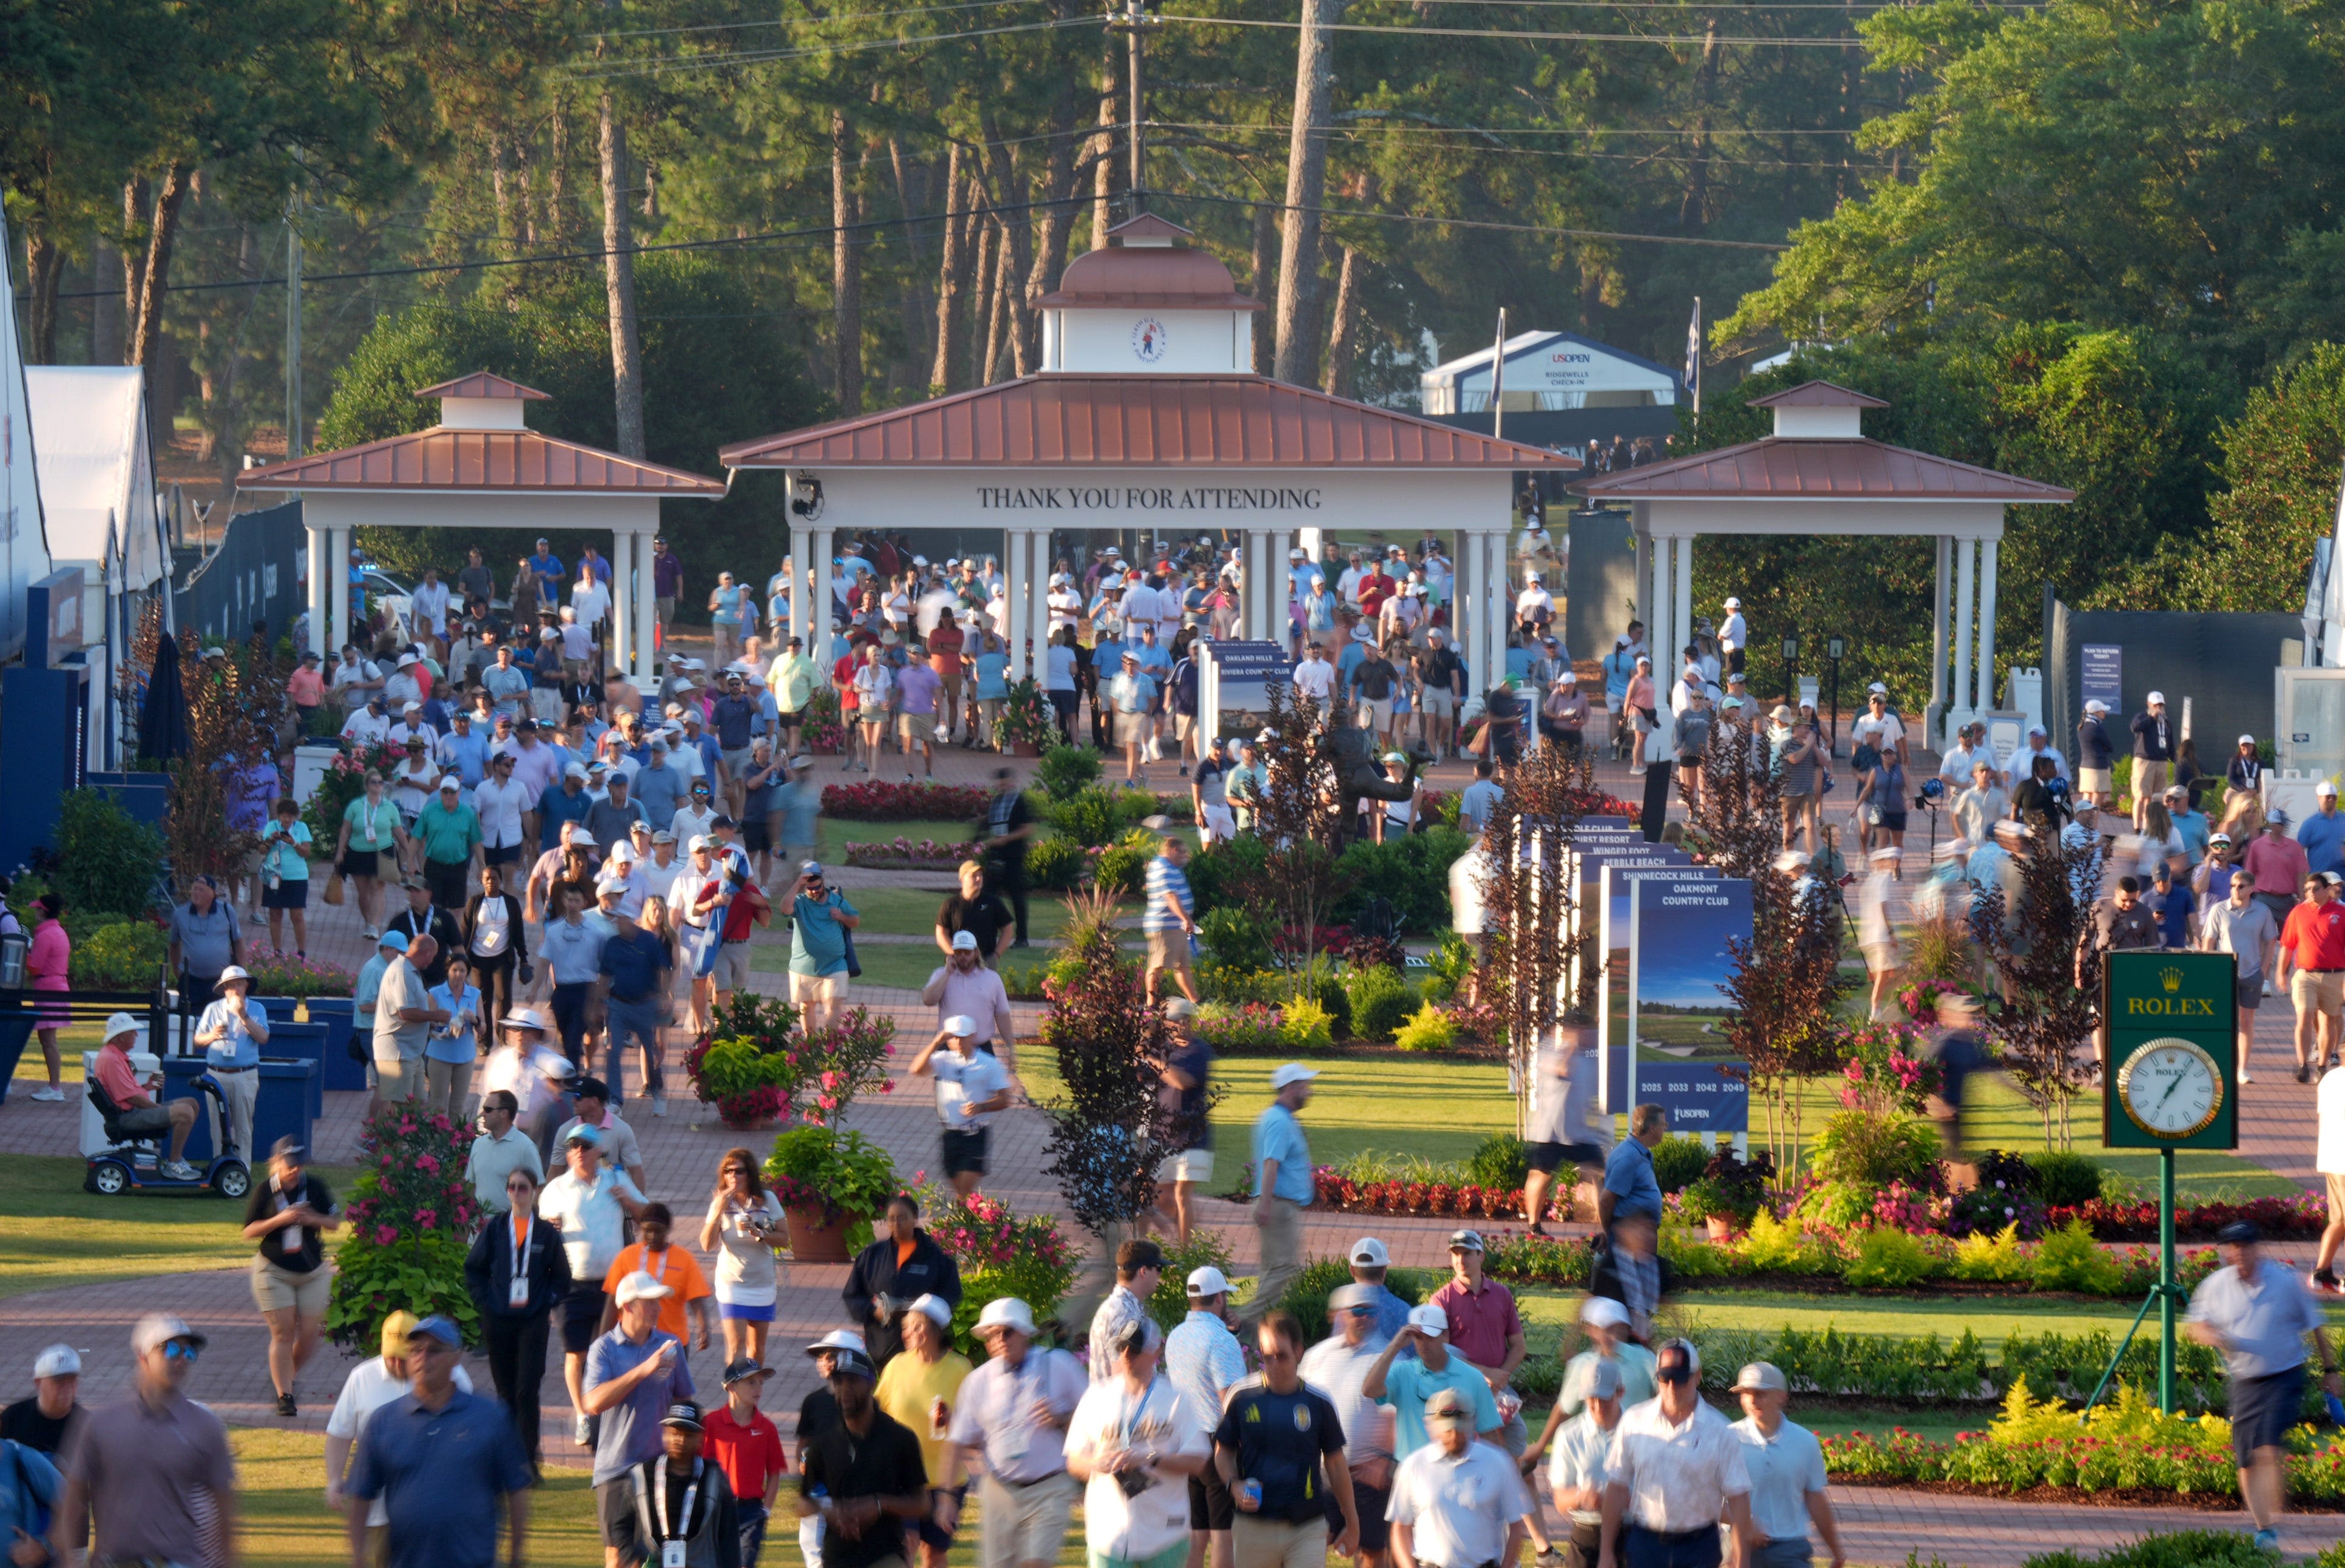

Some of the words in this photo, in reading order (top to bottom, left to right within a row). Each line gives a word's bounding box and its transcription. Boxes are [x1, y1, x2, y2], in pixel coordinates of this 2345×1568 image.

[978, 488, 1063, 509] THANK
[1067, 488, 1120, 509] YOU
[1126, 488, 1174, 509] FOR
[1180, 488, 1322, 510] ATTENDING
[1599, 835, 1631, 844] RESORT
[1603, 858, 1635, 867] PEBBLE
[1637, 858, 1666, 867] BEACH
[1622, 871, 1678, 880] SHINNECOCK
[1680, 871, 1704, 880] HILLS
[1673, 884, 1718, 894] OAKMONT
[1662, 896, 1704, 906] COUNTRY
[1705, 896, 1729, 905] CLUB
[2127, 997, 2216, 1016] ROLEX
[1642, 1083, 1662, 1092] 2025
[1668, 1083, 1688, 1092] 2033
[1695, 1083, 1717, 1092] 2042
[1722, 1083, 1744, 1092] 2049
